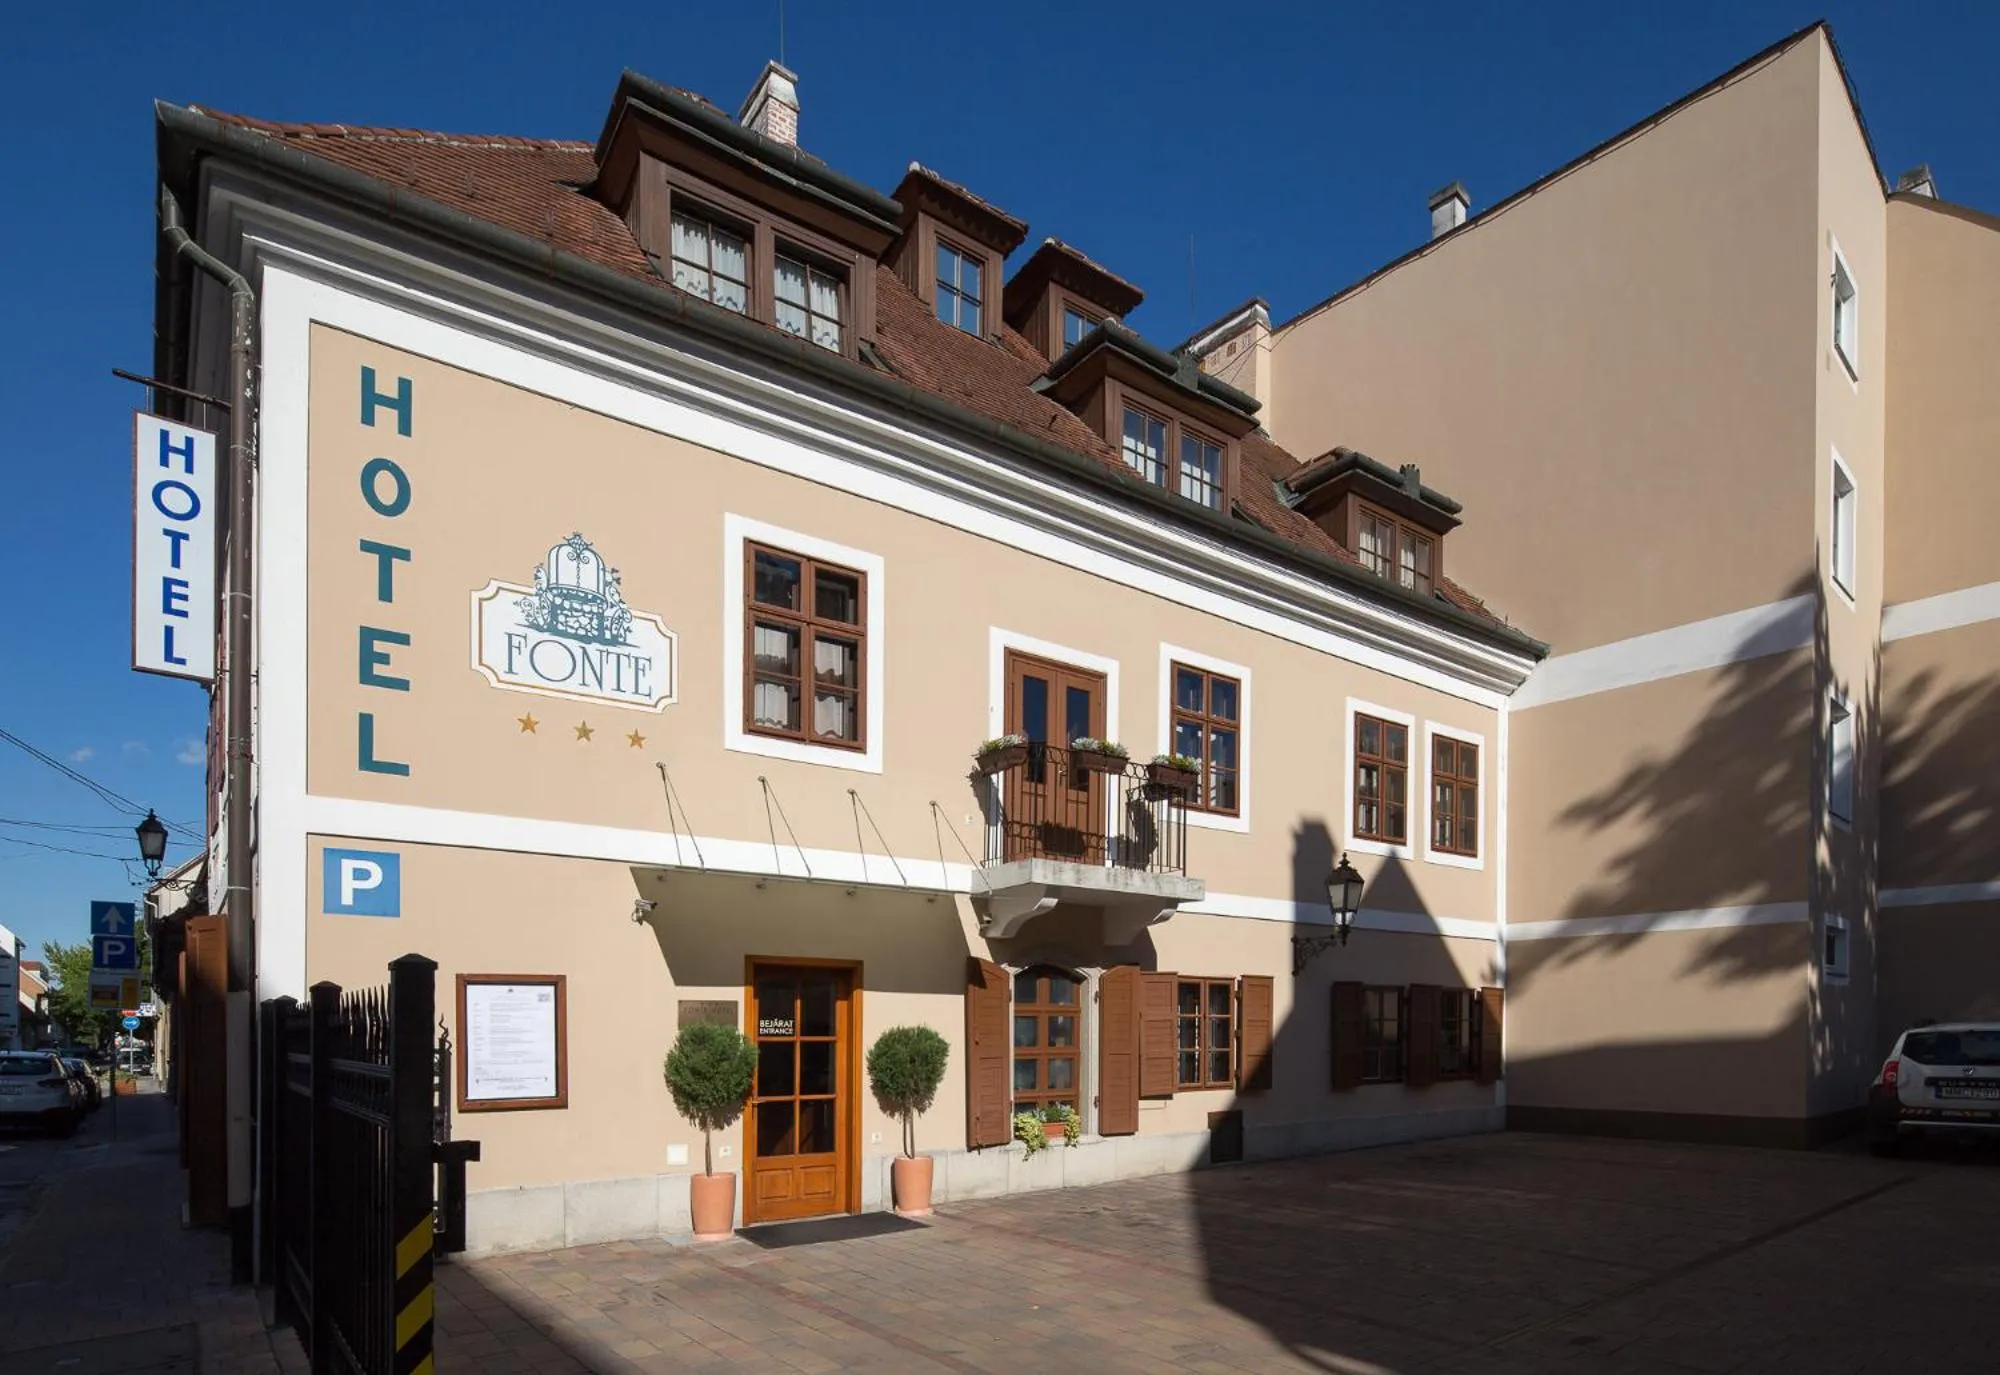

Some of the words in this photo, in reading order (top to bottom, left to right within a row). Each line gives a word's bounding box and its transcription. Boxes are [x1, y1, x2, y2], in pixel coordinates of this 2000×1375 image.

[152, 428, 200, 665] HOTEL
[359, 365, 413, 776] HOTEL
[503, 631, 653, 700] FONTE
[340, 857, 384, 906] P
[103, 941, 126, 964] P
[759, 1017, 793, 1028] BEJÁRAT
[759, 1027, 793, 1035] ENTRANCE
